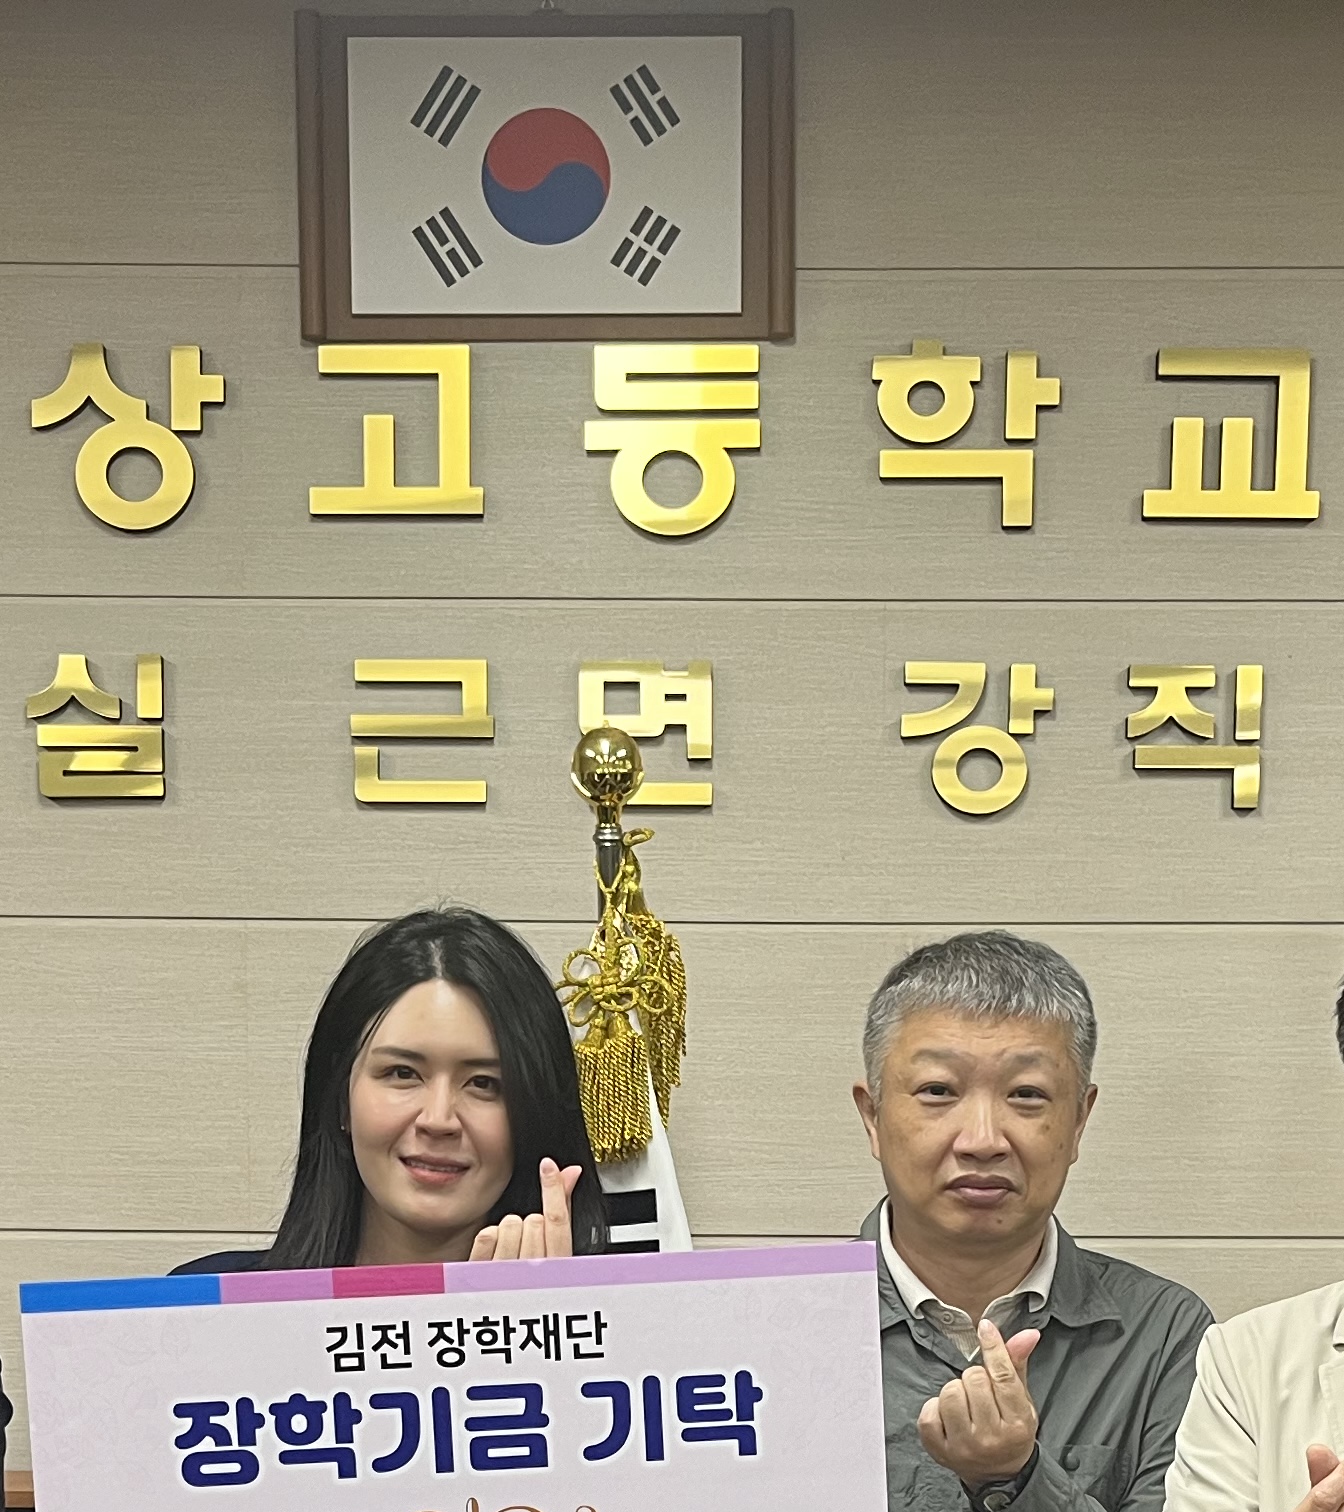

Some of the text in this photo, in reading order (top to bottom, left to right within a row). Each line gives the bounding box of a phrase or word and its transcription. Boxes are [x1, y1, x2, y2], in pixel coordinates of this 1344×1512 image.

[349, 656, 716, 810] 근면
[899, 658, 1263, 816] 강직
[324, 1310, 608, 1373] 김전 장학재단
[172, 1369, 764, 1488] 장학기금 기탁
